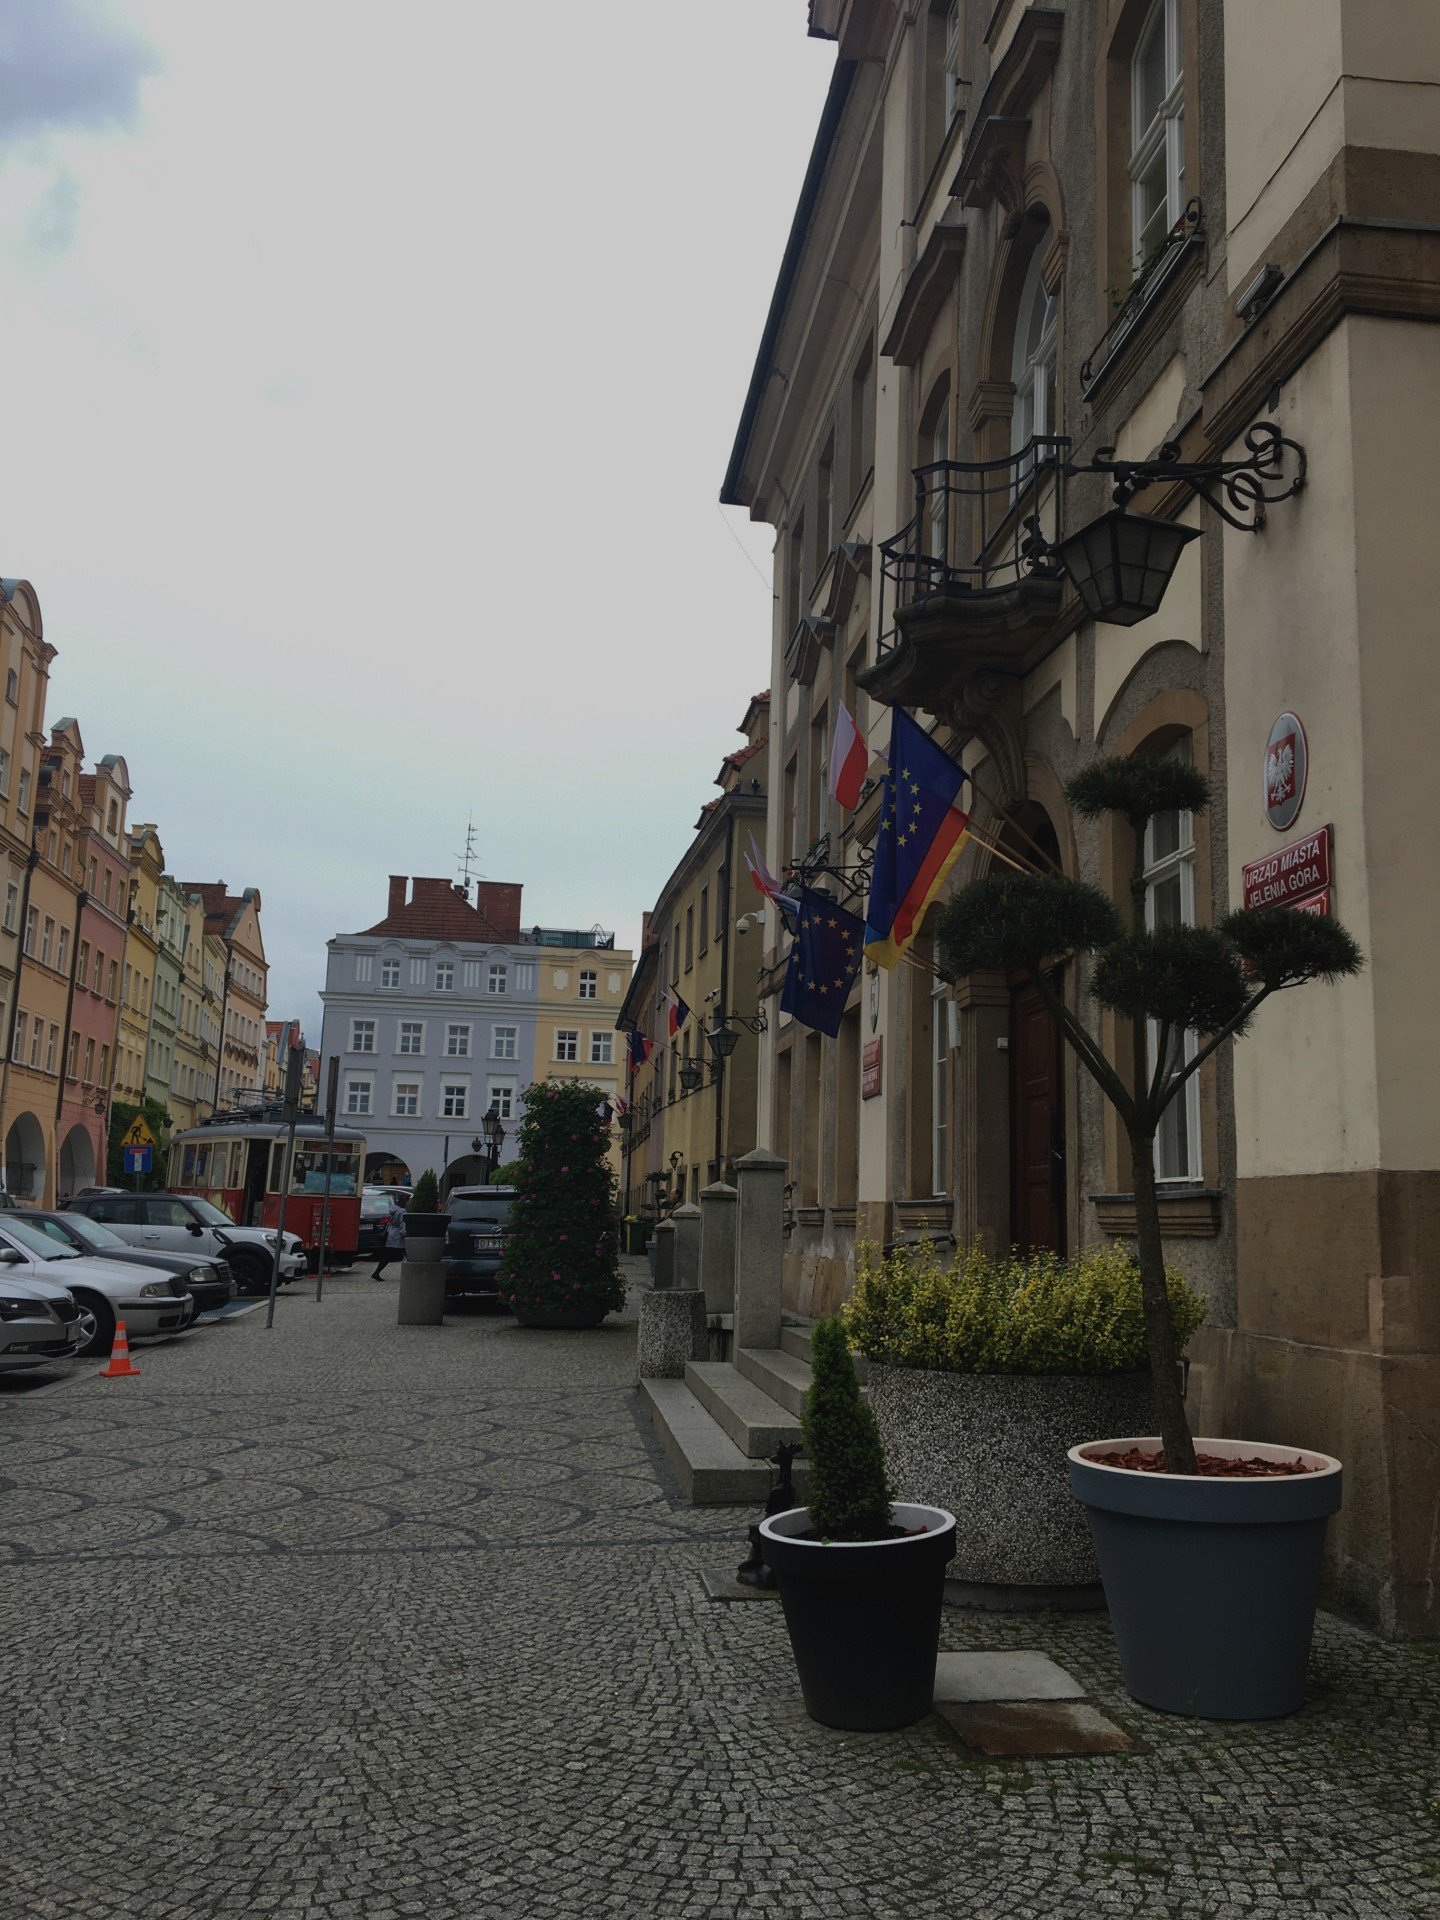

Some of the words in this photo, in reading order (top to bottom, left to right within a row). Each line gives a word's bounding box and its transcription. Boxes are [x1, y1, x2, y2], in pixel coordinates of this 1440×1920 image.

[1246, 860, 1278, 888] URZĄD
[1281, 840, 1320, 872] MIASTA
[1249, 879, 1288, 909] JELENIA
[1289, 866, 1320, 890] GÓRA
